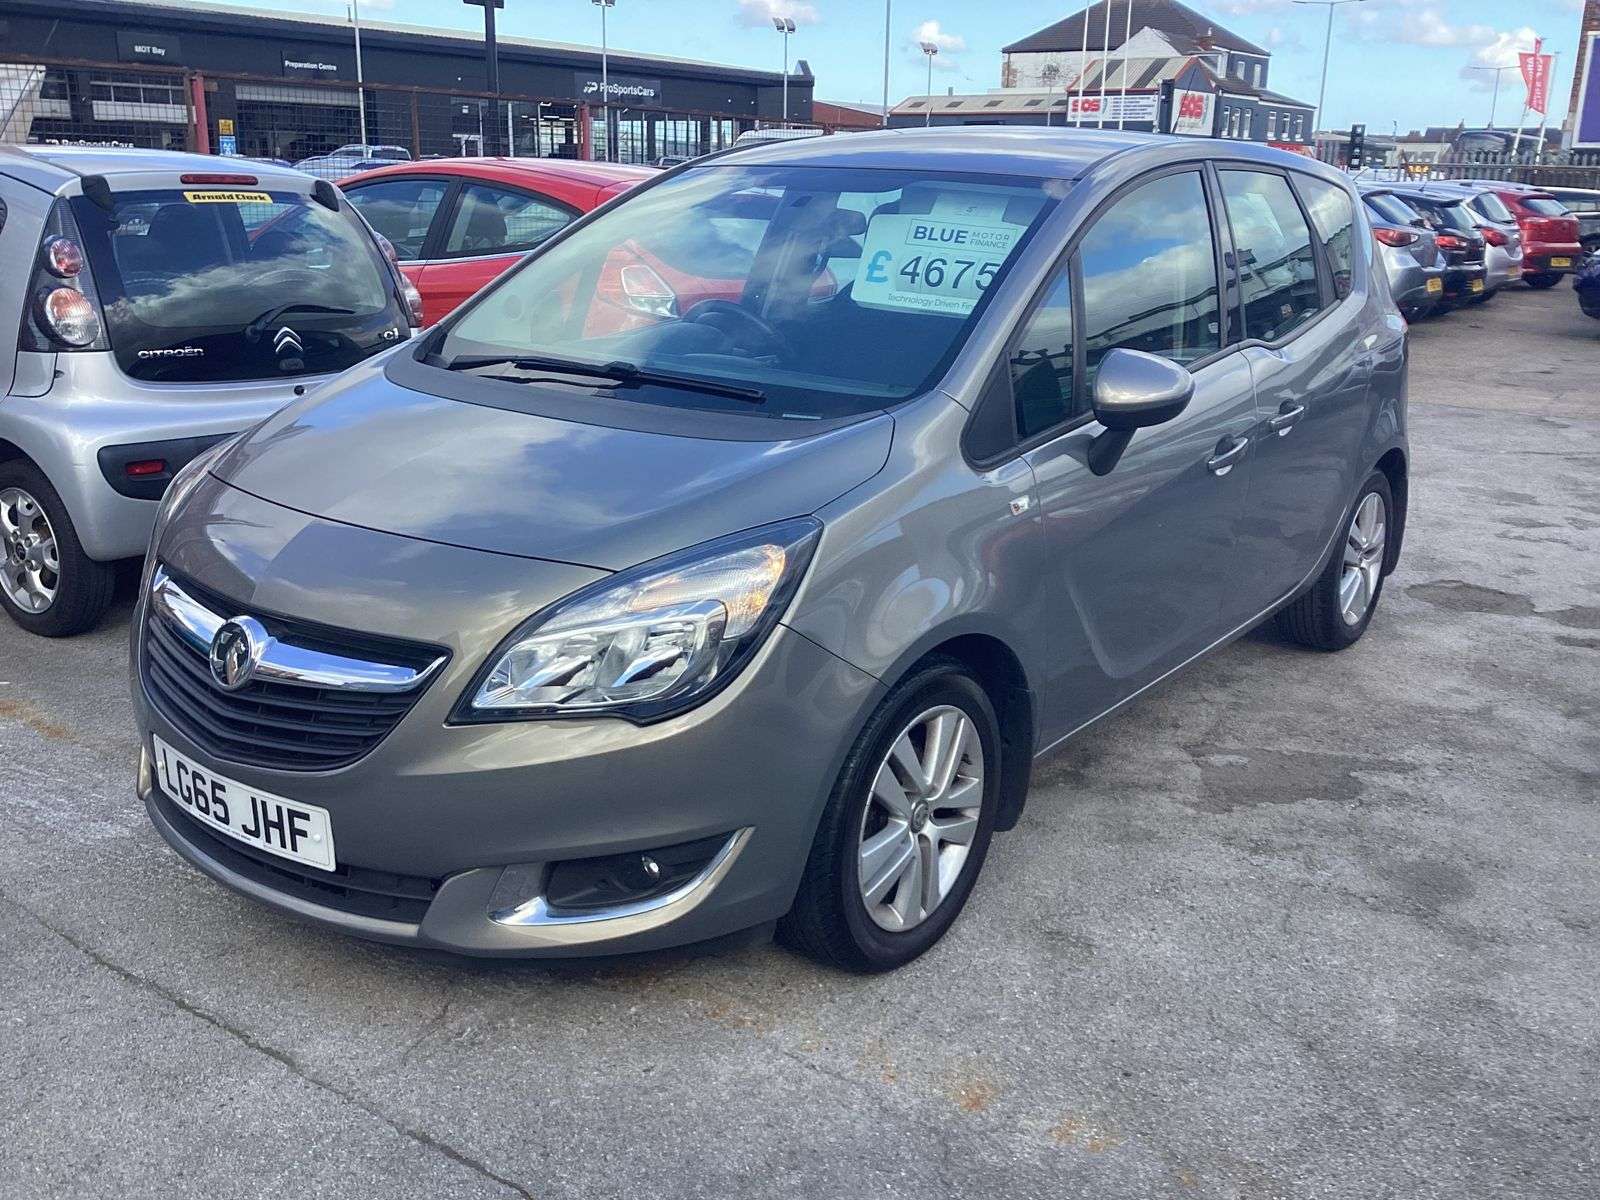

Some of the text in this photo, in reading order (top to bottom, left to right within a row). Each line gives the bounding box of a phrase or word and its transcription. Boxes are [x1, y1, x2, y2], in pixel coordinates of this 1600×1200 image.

[134, 45, 166, 56] MOT Bay
[284, 59, 338, 71] Preparation Centre
[599, 82, 655, 97] ProSportsCars
[192, 192, 267, 202] Arnold Clark
[913, 225, 1010, 244] BLUE MOTOR
[969, 238, 1009, 249] FINANCE
[888, 292, 934, 306] Technology
[935, 299, 960, 310] Driven
[162, 747, 230, 826] LG65
[241, 796, 311, 853] JHF
